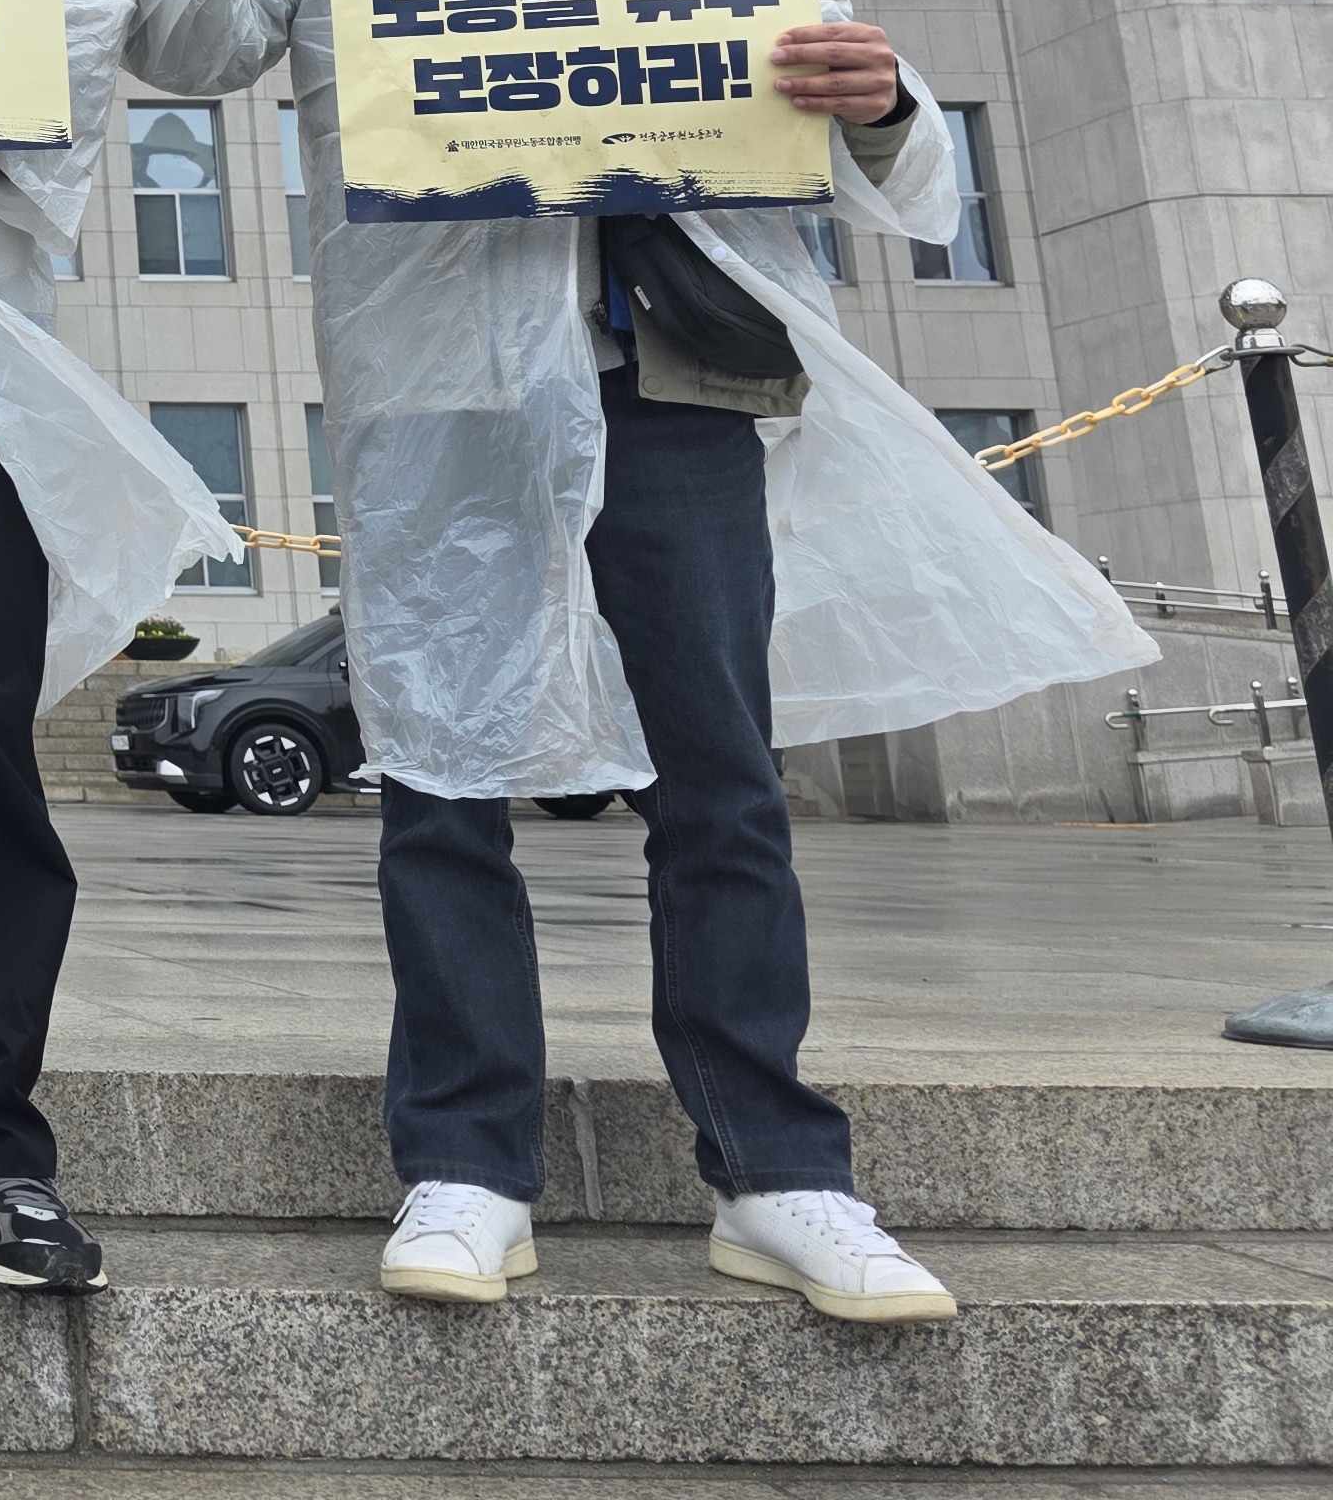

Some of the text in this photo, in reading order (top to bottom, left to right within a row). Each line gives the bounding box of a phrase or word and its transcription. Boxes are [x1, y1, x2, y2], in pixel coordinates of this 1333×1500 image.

[413, 39, 753, 116] 보장하라!
[460, 128, 724, 150] 대한민국공무원노동조합총연맹 전국공무원노동조합
